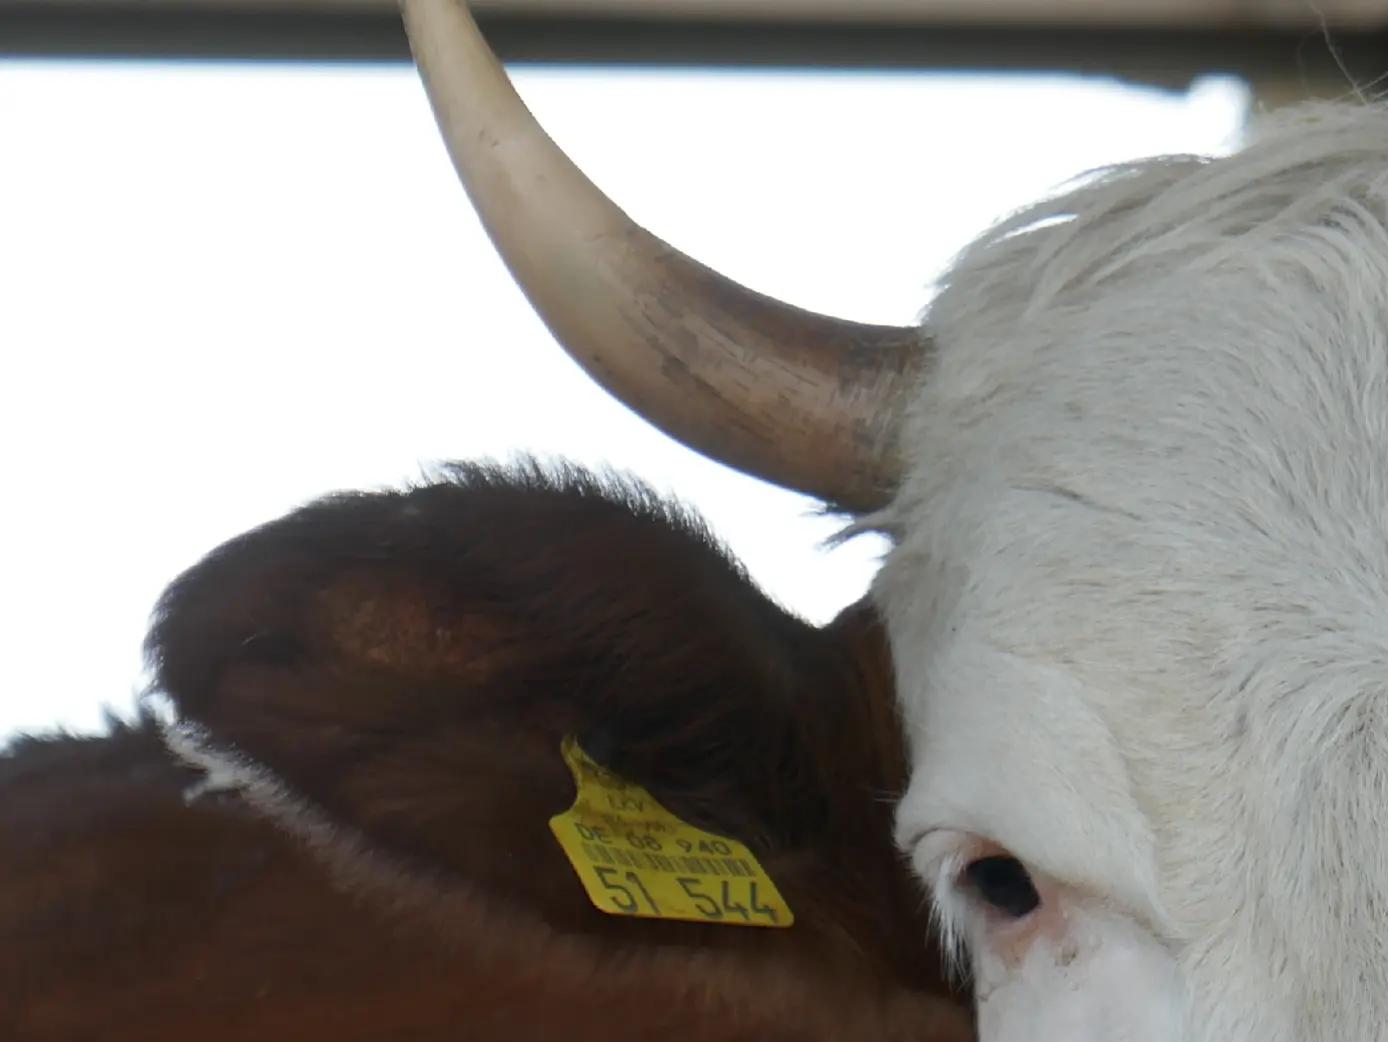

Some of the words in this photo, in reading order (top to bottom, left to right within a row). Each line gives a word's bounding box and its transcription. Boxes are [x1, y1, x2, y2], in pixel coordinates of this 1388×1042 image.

[575, 822, 613, 844] DE
[594, 865, 661, 915] 51
[677, 877, 777, 921] 544
